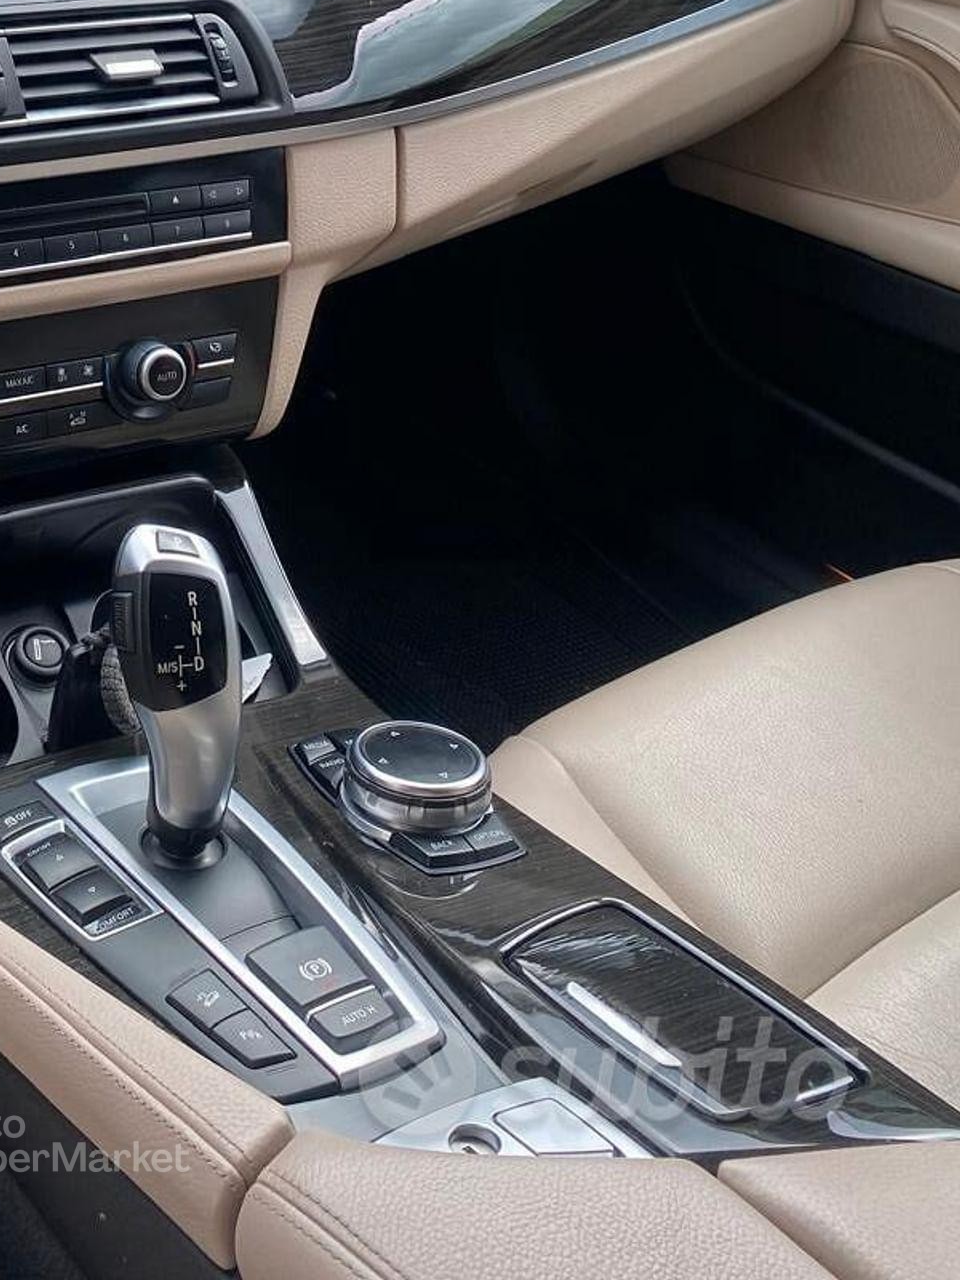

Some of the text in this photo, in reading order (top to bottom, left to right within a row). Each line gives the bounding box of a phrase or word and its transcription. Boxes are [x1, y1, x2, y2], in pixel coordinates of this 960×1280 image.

[156, 370, 178, 382] AUTO
[187, 591, 198, 607] R
[191, 620, 202, 636] N
[157, 655, 205, 675] M/S D
[15, 810, 33, 821] OFF
